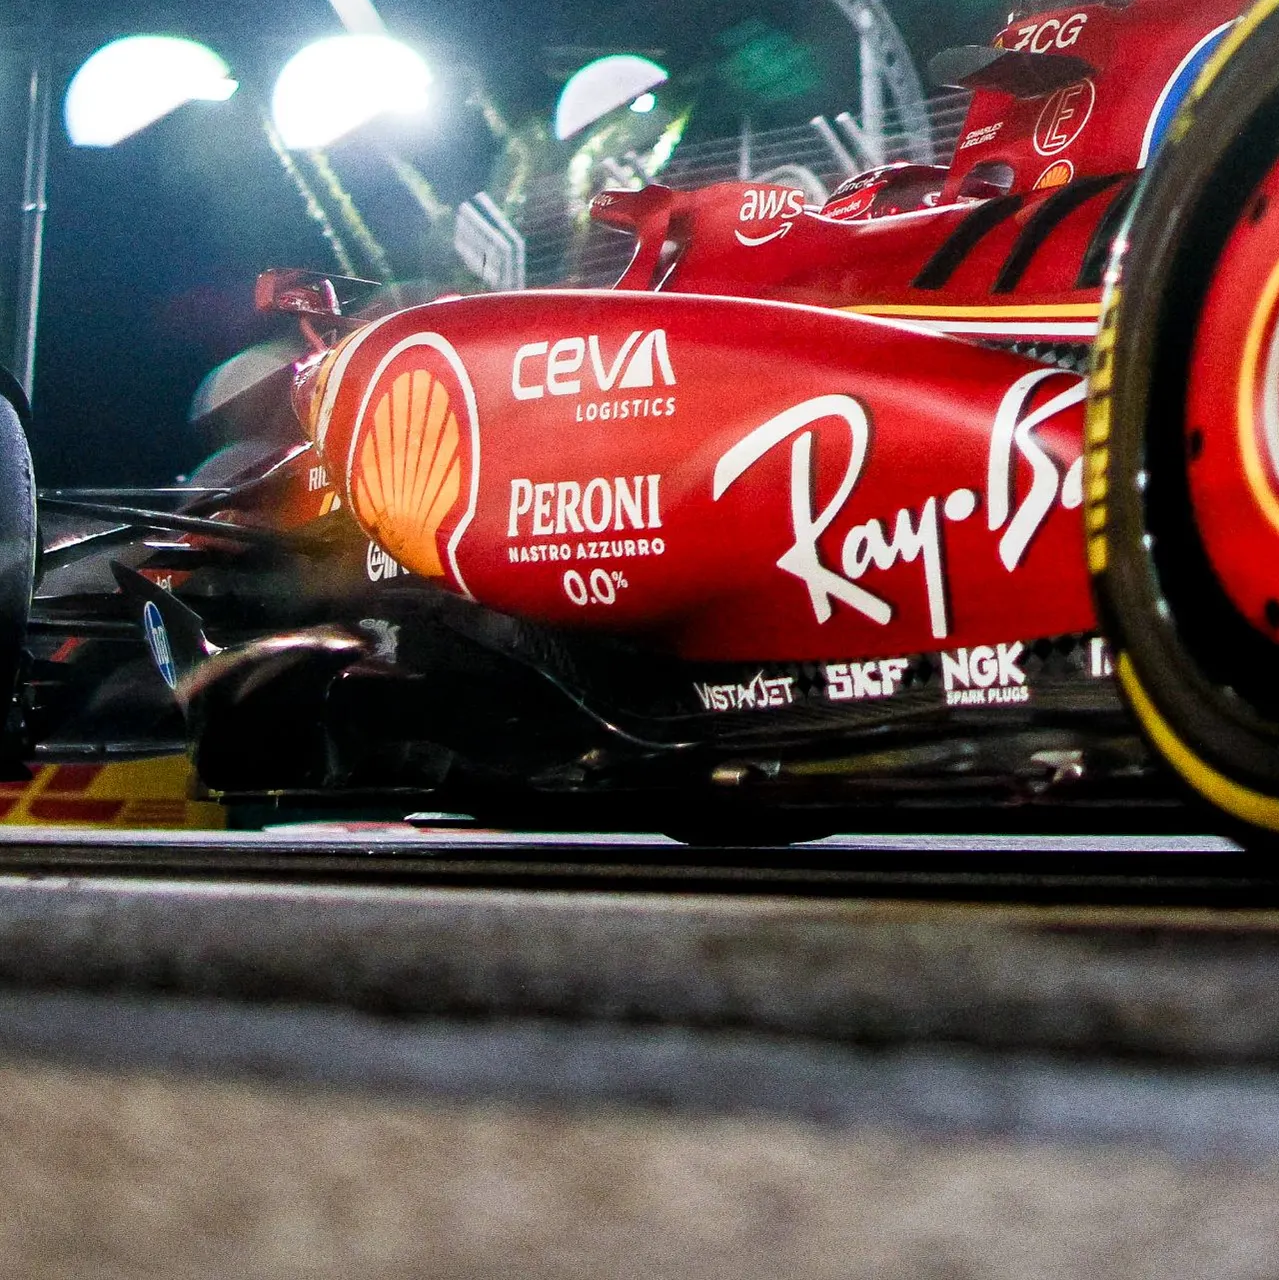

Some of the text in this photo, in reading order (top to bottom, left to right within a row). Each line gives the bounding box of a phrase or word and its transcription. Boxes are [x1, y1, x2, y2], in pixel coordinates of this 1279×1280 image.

[959, 131, 997, 150] LECLERC
[965, 121, 1004, 140] CHARLES
[738, 189, 805, 222] aws
[575, 397, 677, 422] LOGISTICS
[506, 473, 663, 538] PERONI
[507, 537, 666, 564] NASTRO AZZURRO
[562, 568, 629, 607] 0.0%
[825, 657, 910, 700] SKF
[940, 640, 1027, 691] NGK
[946, 685, 1029, 706] SPARK PLUGS
